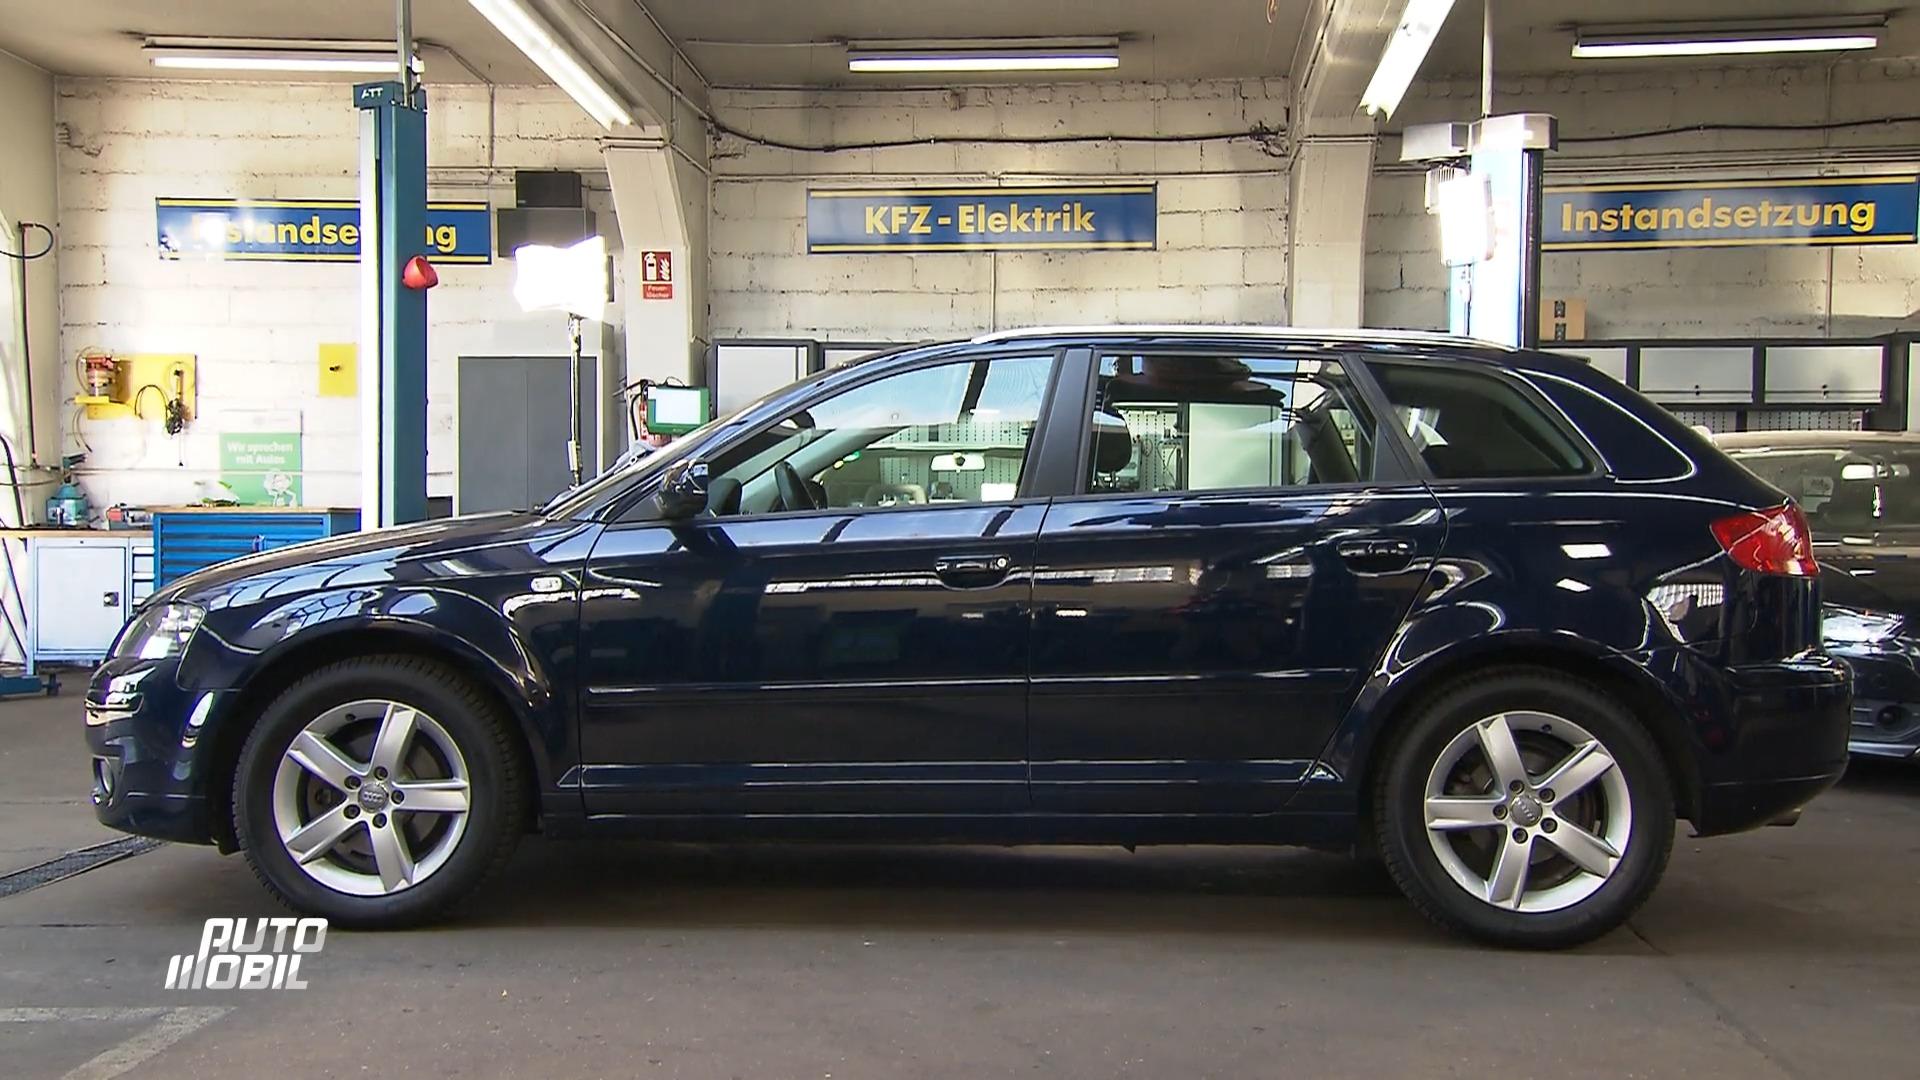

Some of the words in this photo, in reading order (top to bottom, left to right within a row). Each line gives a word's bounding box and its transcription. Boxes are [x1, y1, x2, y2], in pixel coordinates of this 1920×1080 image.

[361, 87, 383, 99] ATT
[1561, 197, 1876, 233] Instandsetzung
[227, 441, 245, 453] Wir
[247, 441, 294, 455] sprechen
[236, 454, 254, 465] mit
[255, 454, 286, 465] Autos
